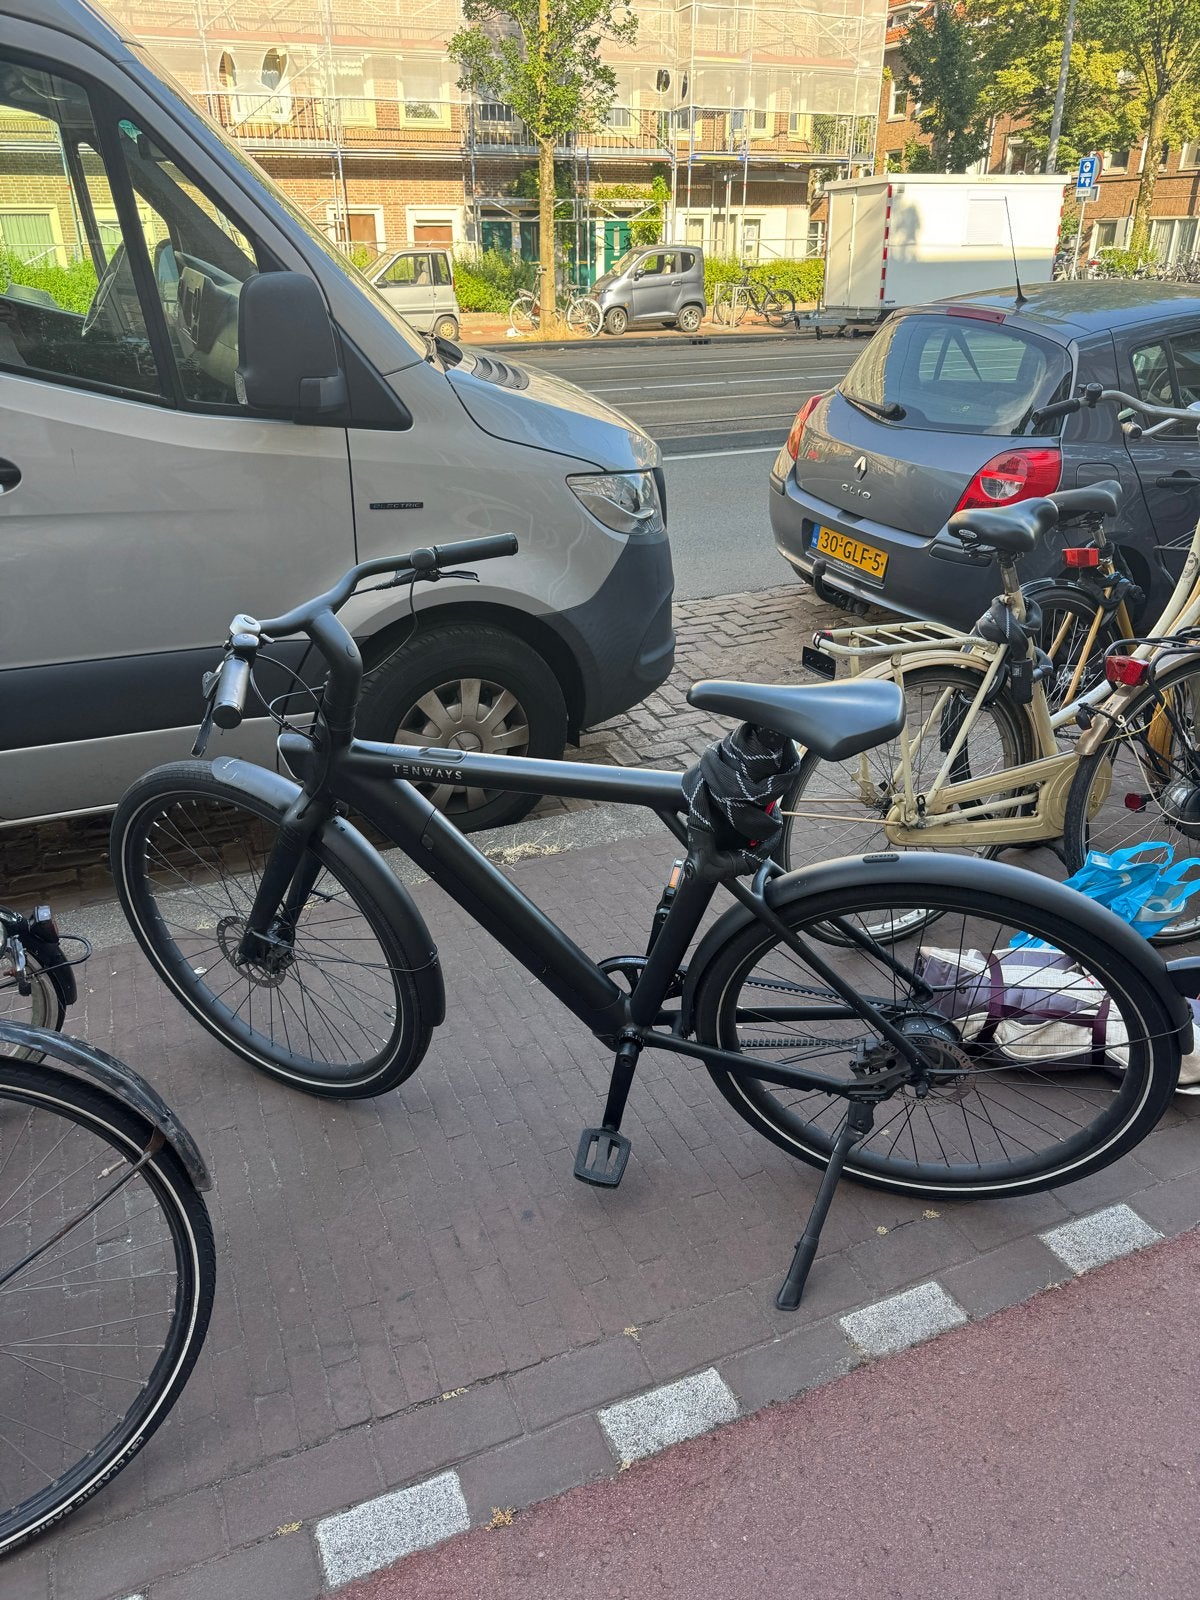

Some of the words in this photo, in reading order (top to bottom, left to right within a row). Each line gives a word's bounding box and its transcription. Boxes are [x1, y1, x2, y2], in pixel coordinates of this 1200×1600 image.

[841, 483, 871, 499] CLIO
[392, 763, 462, 780] TENWAYS
[127, 1436, 144, 1456] CST
[76, 1458, 125, 1505] CLASSIC
[32, 1505, 73, 1535] BASIC
